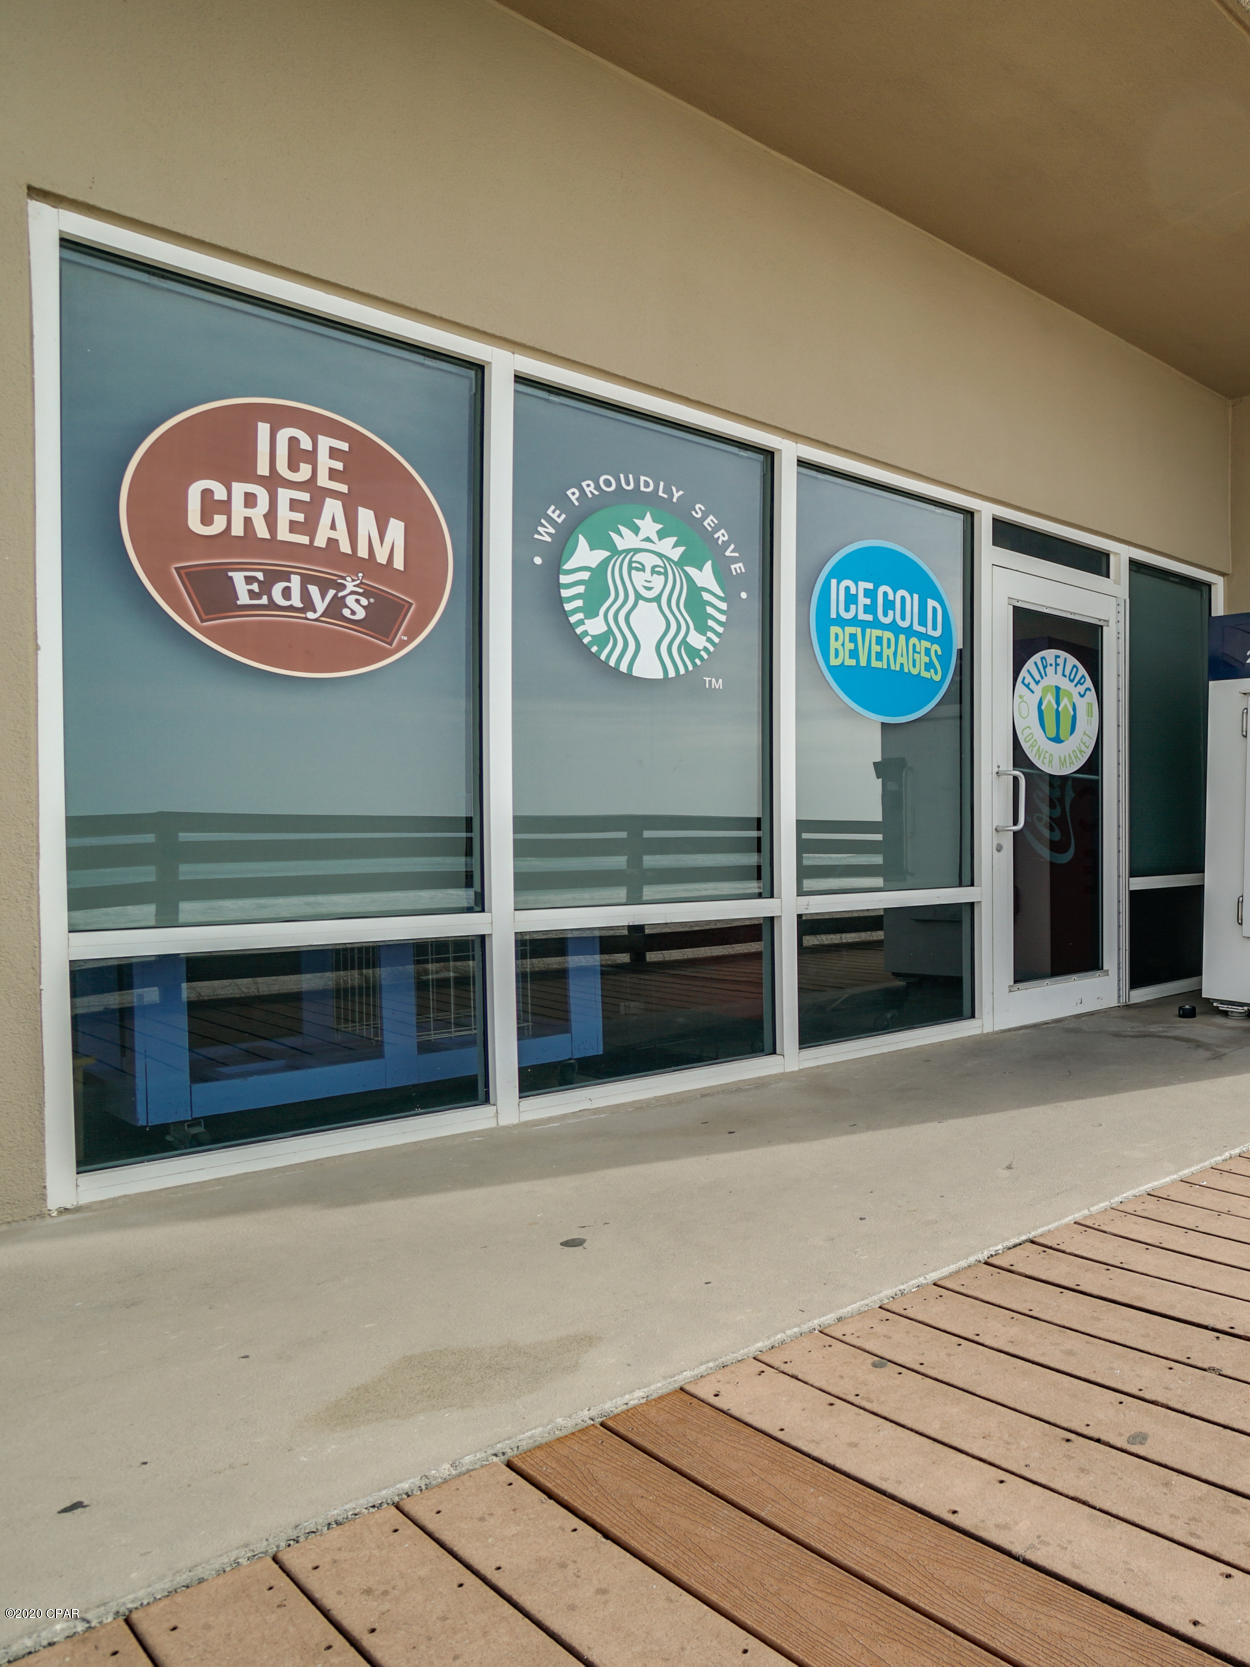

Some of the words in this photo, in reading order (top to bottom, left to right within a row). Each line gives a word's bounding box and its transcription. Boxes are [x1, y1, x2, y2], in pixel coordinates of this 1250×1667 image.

[256, 421, 350, 494] ICE
[187, 479, 406, 572] CREAM
[533, 504, 567, 543] WE
[566, 473, 685, 506] PROUDLY
[690, 503, 746, 576] SERVE
[227, 570, 370, 621] Edy's
[829, 578, 874, 621] ICE
[876, 584, 943, 638] COLD
[829, 625, 943, 682] BEVERAGES
[1020, 654, 1092, 698] FLIP-FLOPS
[703, 677, 724, 690] TM
[1021, 725, 1054, 769] CORNER
[1058, 730, 1094, 769] MARKET
